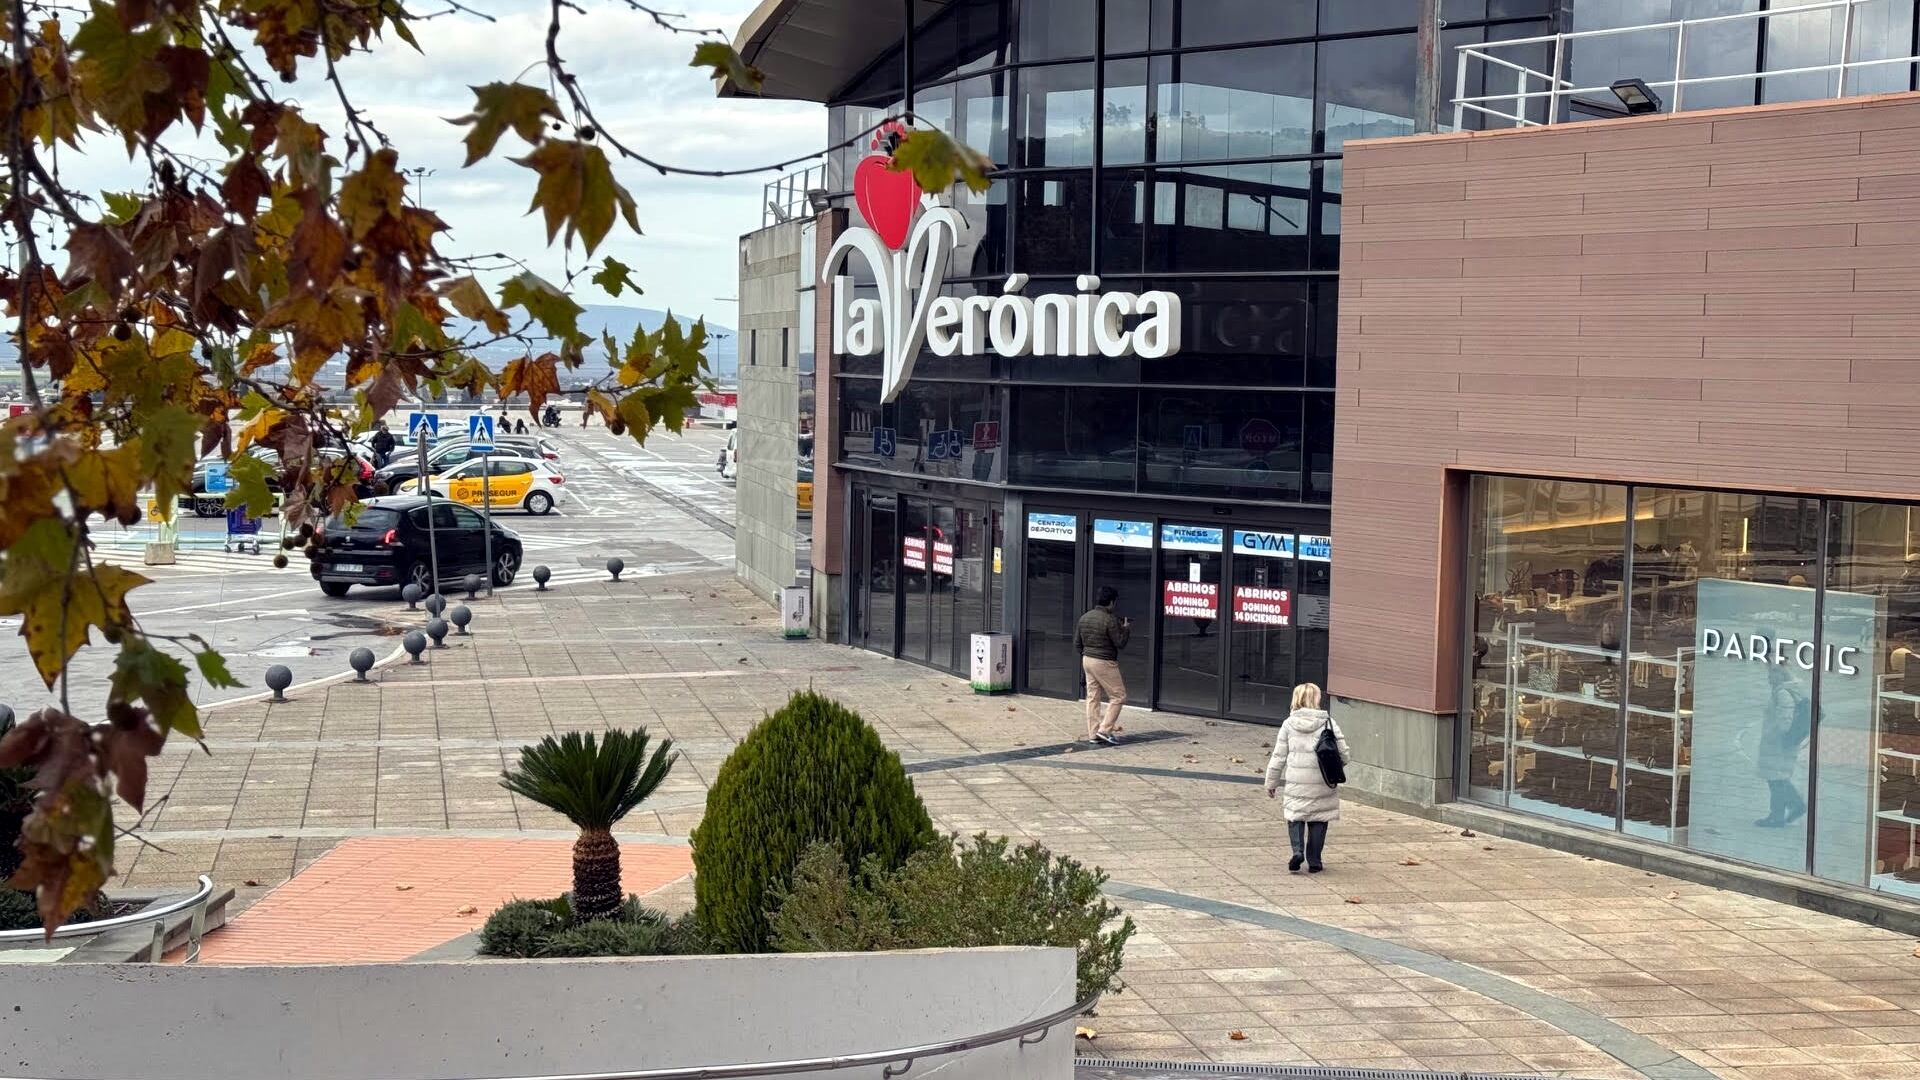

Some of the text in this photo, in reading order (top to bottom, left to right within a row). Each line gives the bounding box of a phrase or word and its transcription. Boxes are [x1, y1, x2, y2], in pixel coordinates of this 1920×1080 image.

[822, 205, 1182, 403] Verónica
[833, 275, 883, 356] la
[1030, 526, 1073, 535] DEPORTIVO
[1037, 519, 1066, 528] CENTRO
[1174, 529, 1208, 537] FITNESS
[1242, 532, 1287, 552] GYM
[1166, 581, 1216, 595] ABRIMOS
[1236, 588, 1288, 601] ABRIMOS
[1172, 595, 1210, 607] DOMINGO
[1242, 602, 1281, 614] DOMINGO
[1165, 605, 1217, 619] 14 DICIEMBRE
[1234, 611, 1289, 625] 14 DICIEMBRE
[1702, 628, 1858, 675] PARFOIS
